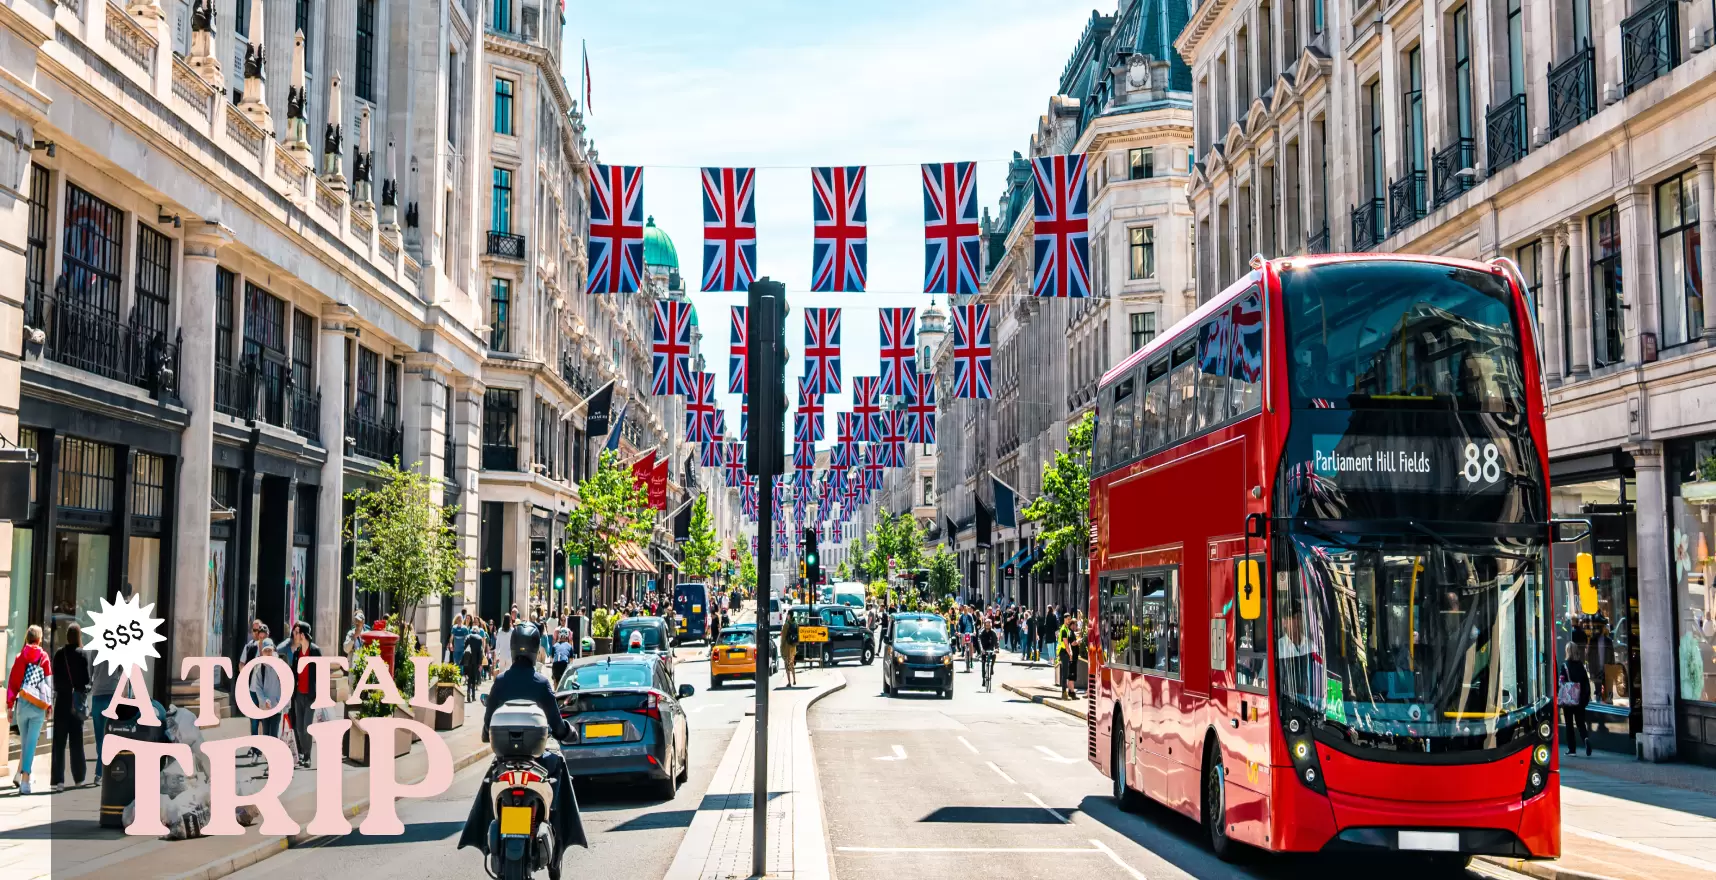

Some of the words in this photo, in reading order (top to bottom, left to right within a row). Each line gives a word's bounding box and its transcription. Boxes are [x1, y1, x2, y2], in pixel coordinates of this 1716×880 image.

[1315, 450, 1373, 472] Parliament
[1376, 451, 1396, 472] Hill
[1399, 451, 1431, 473] Fields
[1464, 443, 1500, 483] 88
